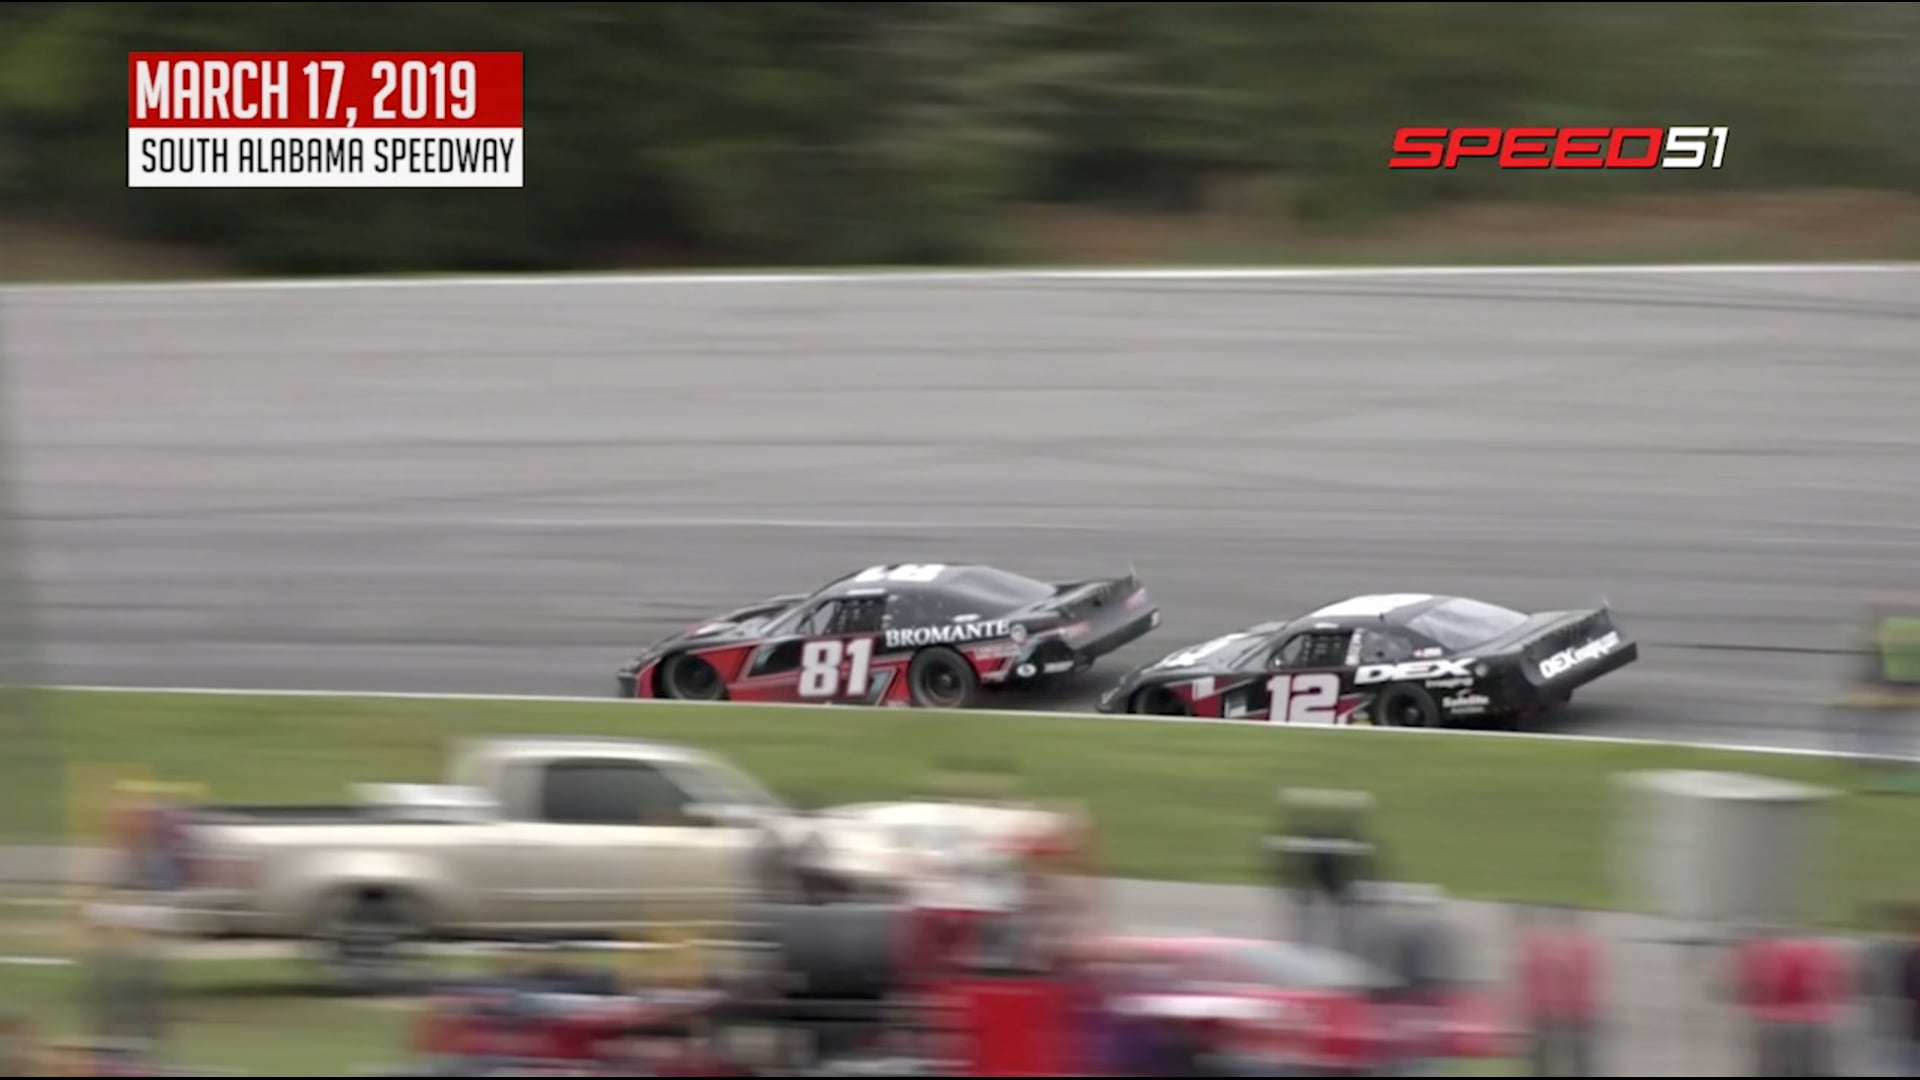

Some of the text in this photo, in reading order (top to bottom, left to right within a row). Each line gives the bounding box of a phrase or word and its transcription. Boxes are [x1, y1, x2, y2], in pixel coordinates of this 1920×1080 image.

[884, 619, 1011, 649] BROMANTE
[798, 637, 874, 697] 81
[1353, 657, 1477, 685] DEX
[1266, 673, 1340, 724] 12
